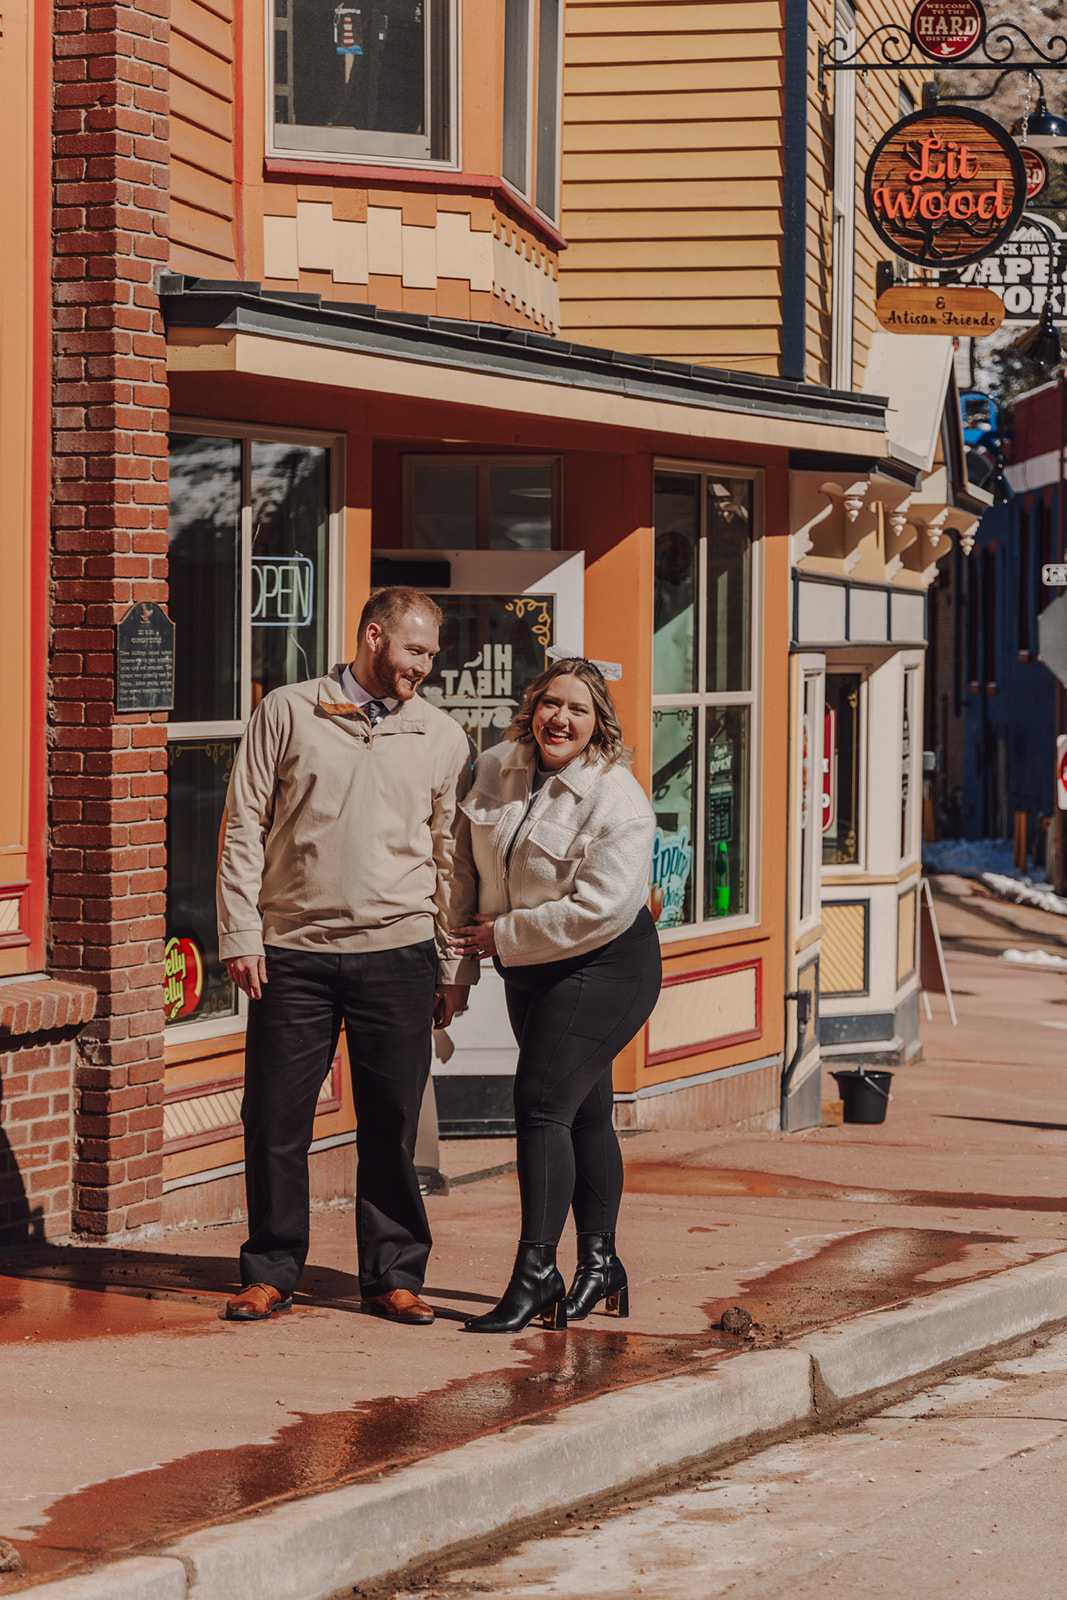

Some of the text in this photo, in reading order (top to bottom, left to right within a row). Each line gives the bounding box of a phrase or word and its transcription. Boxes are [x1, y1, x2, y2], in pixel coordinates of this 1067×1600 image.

[919, 16, 977, 35] HARD
[909, 137, 980, 182] Lit
[873, 179, 1012, 220] Wood
[883, 310, 996, 326] Artisan Friends
[935, 296, 945, 310] &
[709, 755, 733, 775] OPEN
[164, 941, 187, 981] elly
[164, 976, 185, 1019] elly
